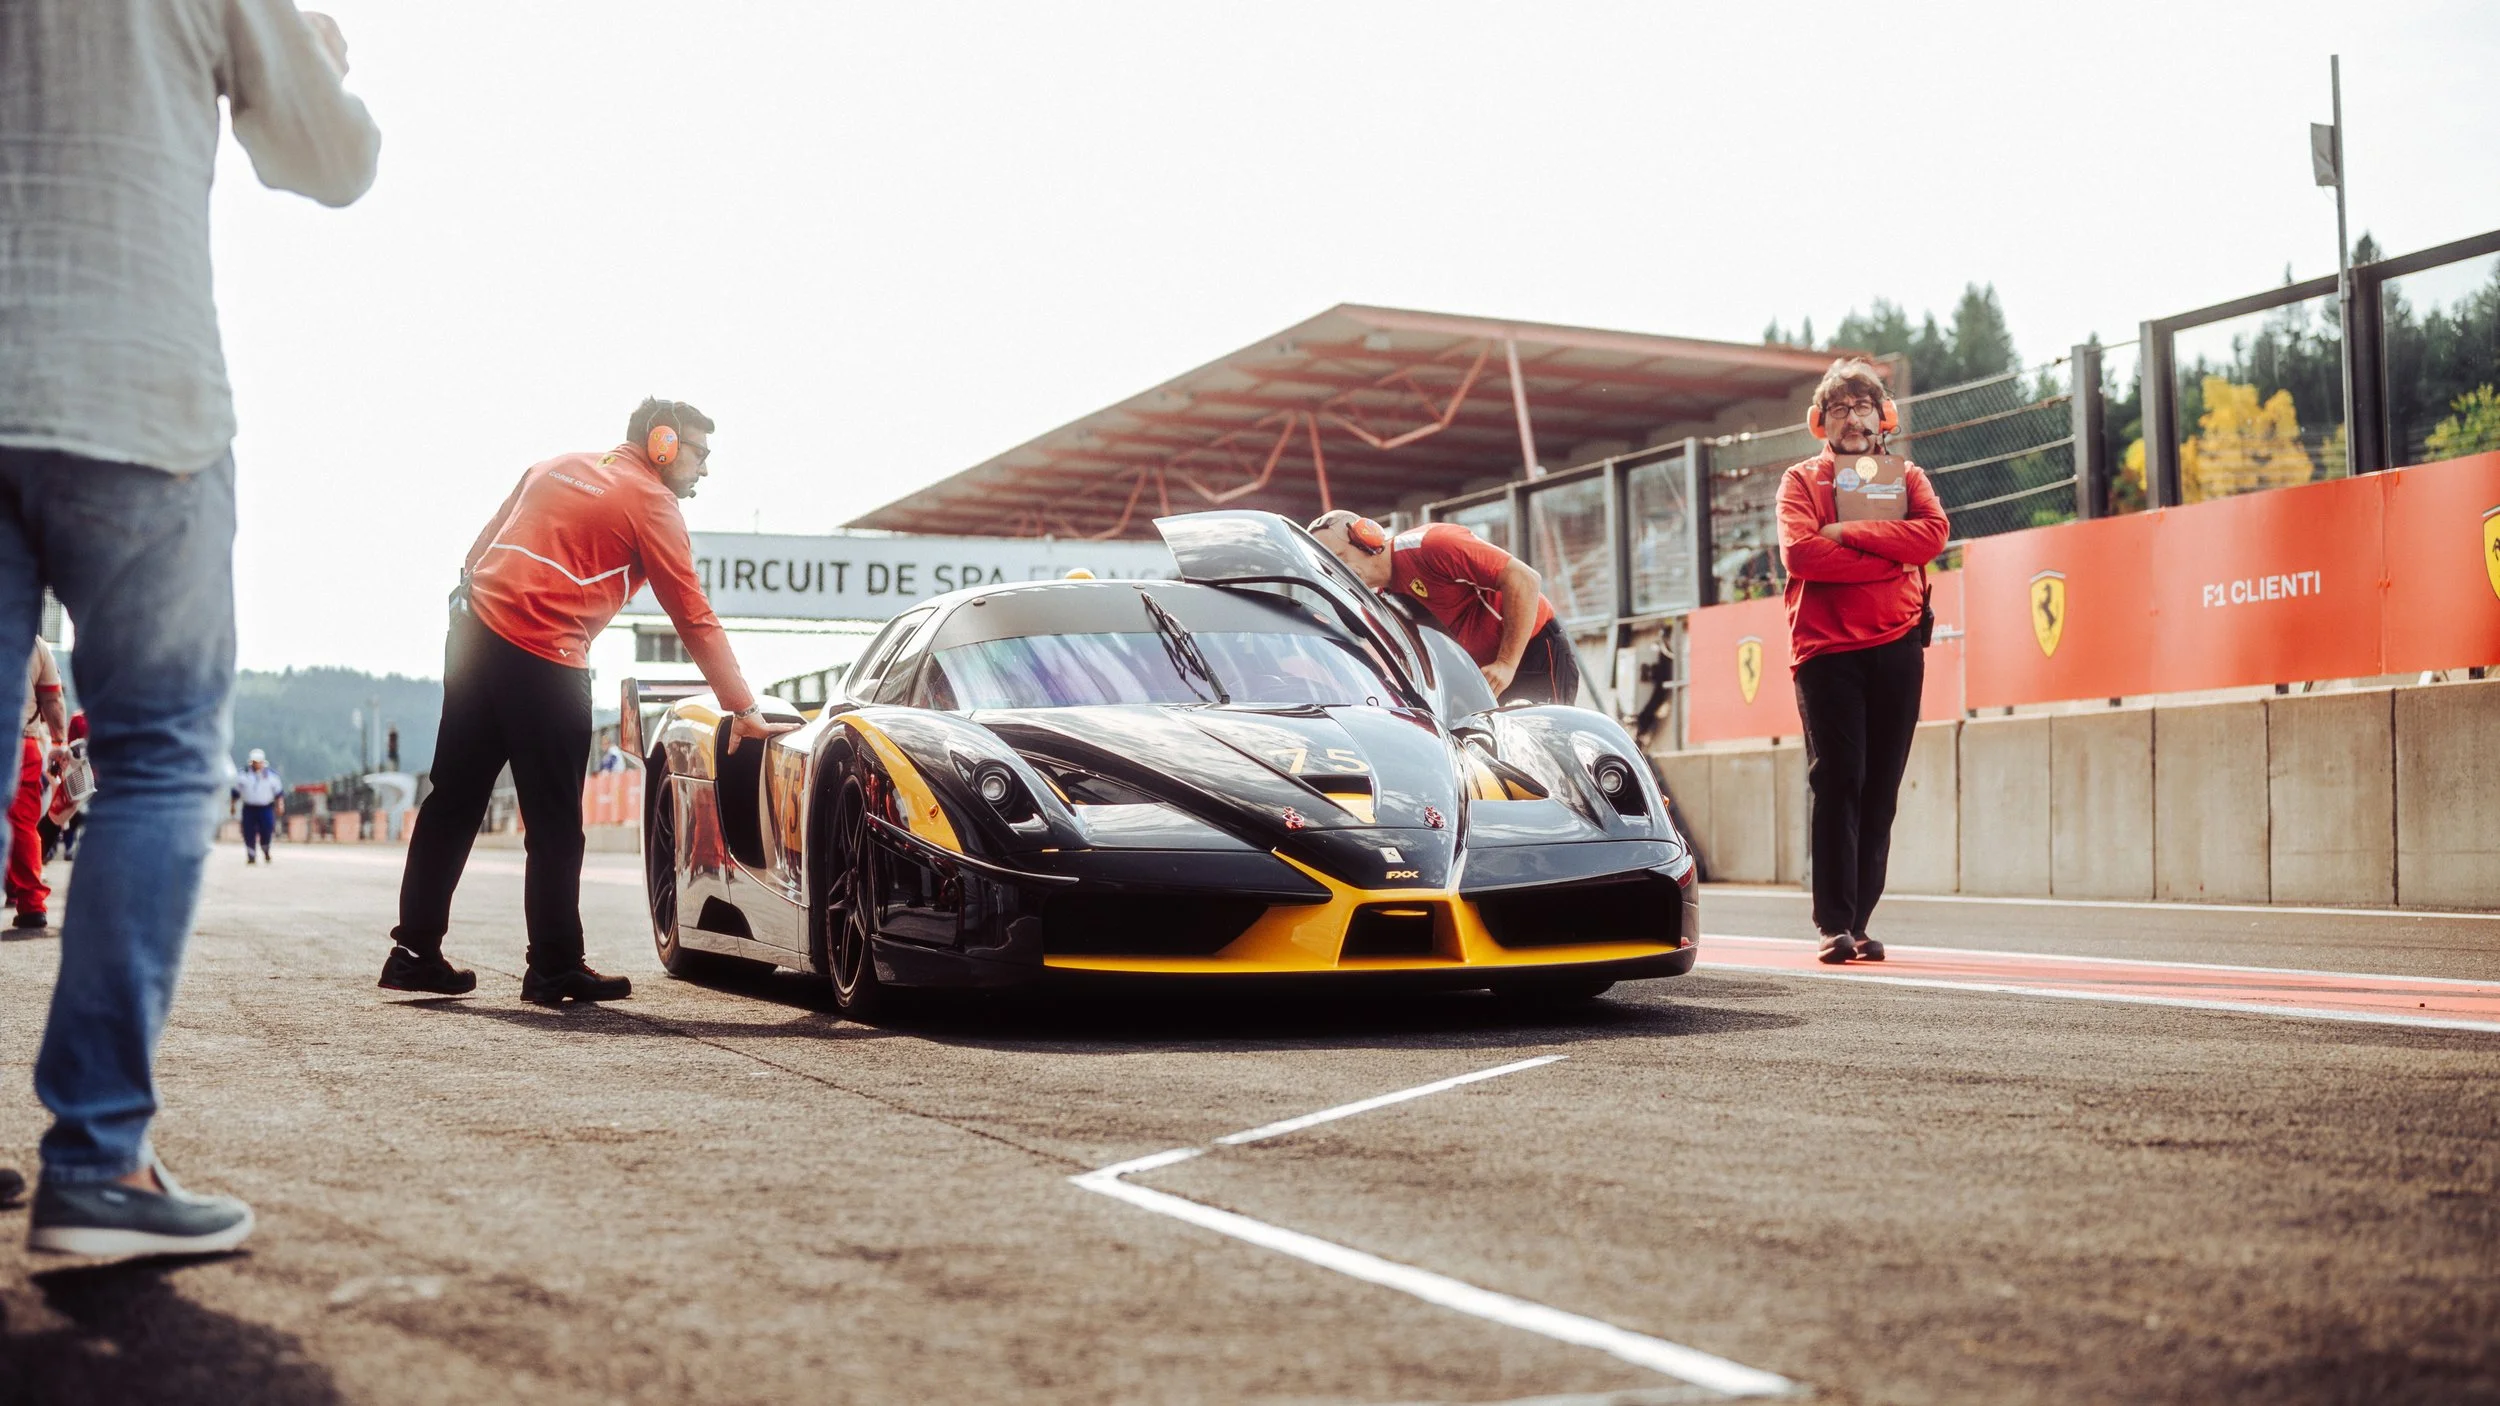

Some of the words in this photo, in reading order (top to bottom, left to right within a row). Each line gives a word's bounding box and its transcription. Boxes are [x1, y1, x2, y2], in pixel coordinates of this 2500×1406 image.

[575, 480, 605, 496] CLIENTI
[867, 563, 916, 595] DE
[2203, 583, 2226, 608] F1
[2231, 570, 2320, 604] CLIENTI
[1266, 747, 1370, 773] 75
[1385, 870, 1419, 880] FXX
